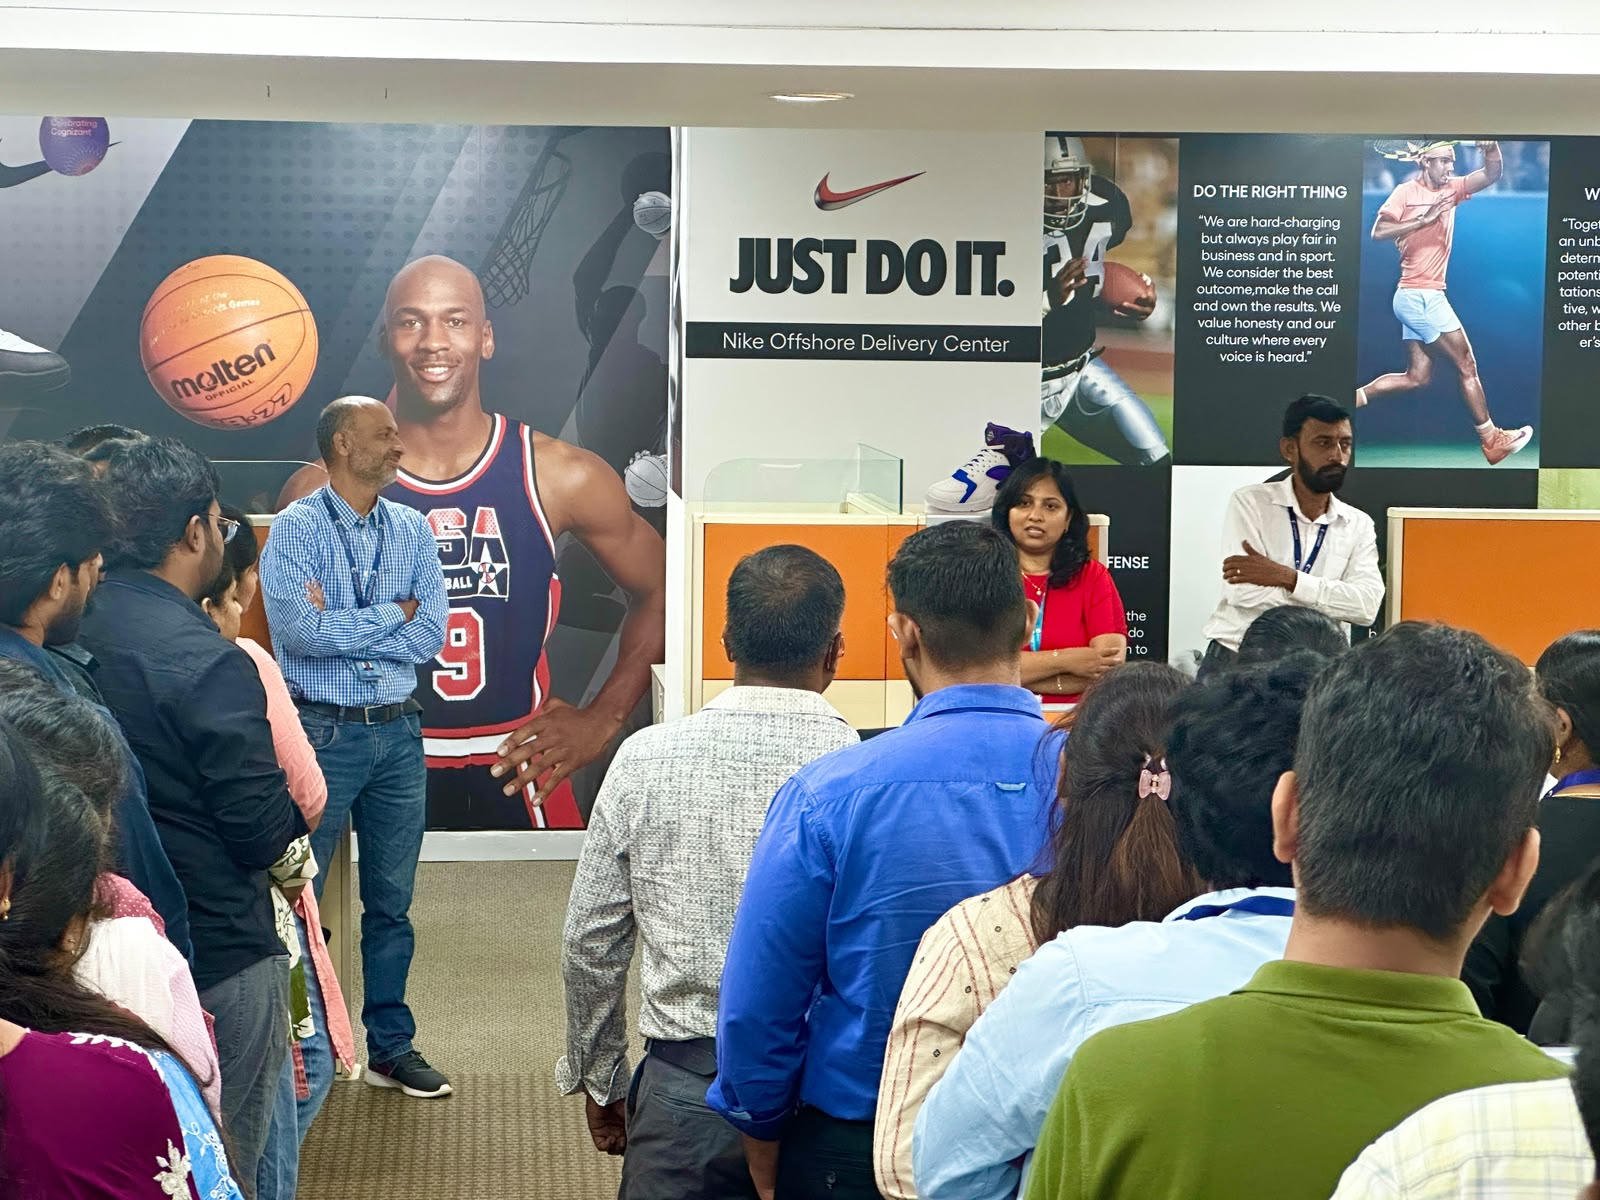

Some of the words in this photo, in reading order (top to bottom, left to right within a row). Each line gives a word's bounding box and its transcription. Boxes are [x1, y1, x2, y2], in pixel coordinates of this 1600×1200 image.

[50, 127, 92, 137] Cognizant
[1193, 184, 1217, 198] DO
[1219, 184, 1249, 198] THE
[1251, 184, 1298, 199] RIGHT
[1299, 185, 1348, 199] THING
[1227, 218, 1248, 228] are
[1250, 215, 1341, 231] hard-charging
[1201, 232, 1223, 244] but
[1225, 233, 1270, 247] always
[1272, 233, 1299, 247] play
[1301, 233, 1323, 245] fair
[1325, 233, 1337, 245] in
[1558, 237, 1576, 247] an
[1201, 249, 1256, 261] business
[1257, 250, 1284, 262] and
[1285, 250, 1298, 262] in
[1300, 252, 1336, 264] sport.
[729, 237, 857, 295] JUST
[865, 238, 948, 297] DO
[955, 240, 1016, 298] IT.
[1203, 266, 1224, 278] We
[1226, 266, 1281, 279] consider
[1282, 267, 1304, 279] the
[1306, 267, 1334, 279] best
[1557, 269, 1600, 283] potenti
[1196, 284, 1291, 297] outcome,make
[1292, 284, 1314, 296] the
[1316, 284, 1339, 296] call
[1193, 300, 1219, 312] and
[1221, 303, 1248, 312] own
[1250, 301, 1272, 312] the
[1274, 301, 1318, 313] results.
[1319, 301, 1342, 313] We
[1562, 302, 1588, 316] tive,
[1197, 317, 1232, 328] value
[1234, 317, 1285, 331] honesty
[1286, 318, 1312, 329] and
[1314, 320, 1337, 330] our
[1557, 319, 1592, 331] other
[723, 332, 764, 350] Nike
[770, 332, 856, 351] Offshore
[861, 334, 938, 355] Delivery
[943, 335, 1010, 353] Center
[1205, 333, 1249, 345] culture
[1251, 334, 1291, 346] where
[1293, 337, 1328, 349] every
[1219, 350, 1253, 362] voice
[1255, 351, 1265, 362] is
[170, 343, 276, 399] molten
[204, 379, 254, 401] OFFICIAL
[426, 506, 510, 590] SA
[1107, 555, 1150, 569] FENSE
[445, 575, 473, 590] BALL
[1126, 610, 1147, 622] the
[1128, 626, 1145, 638] do
[432, 607, 486, 702] 9
[1135, 644, 1148, 655] to
